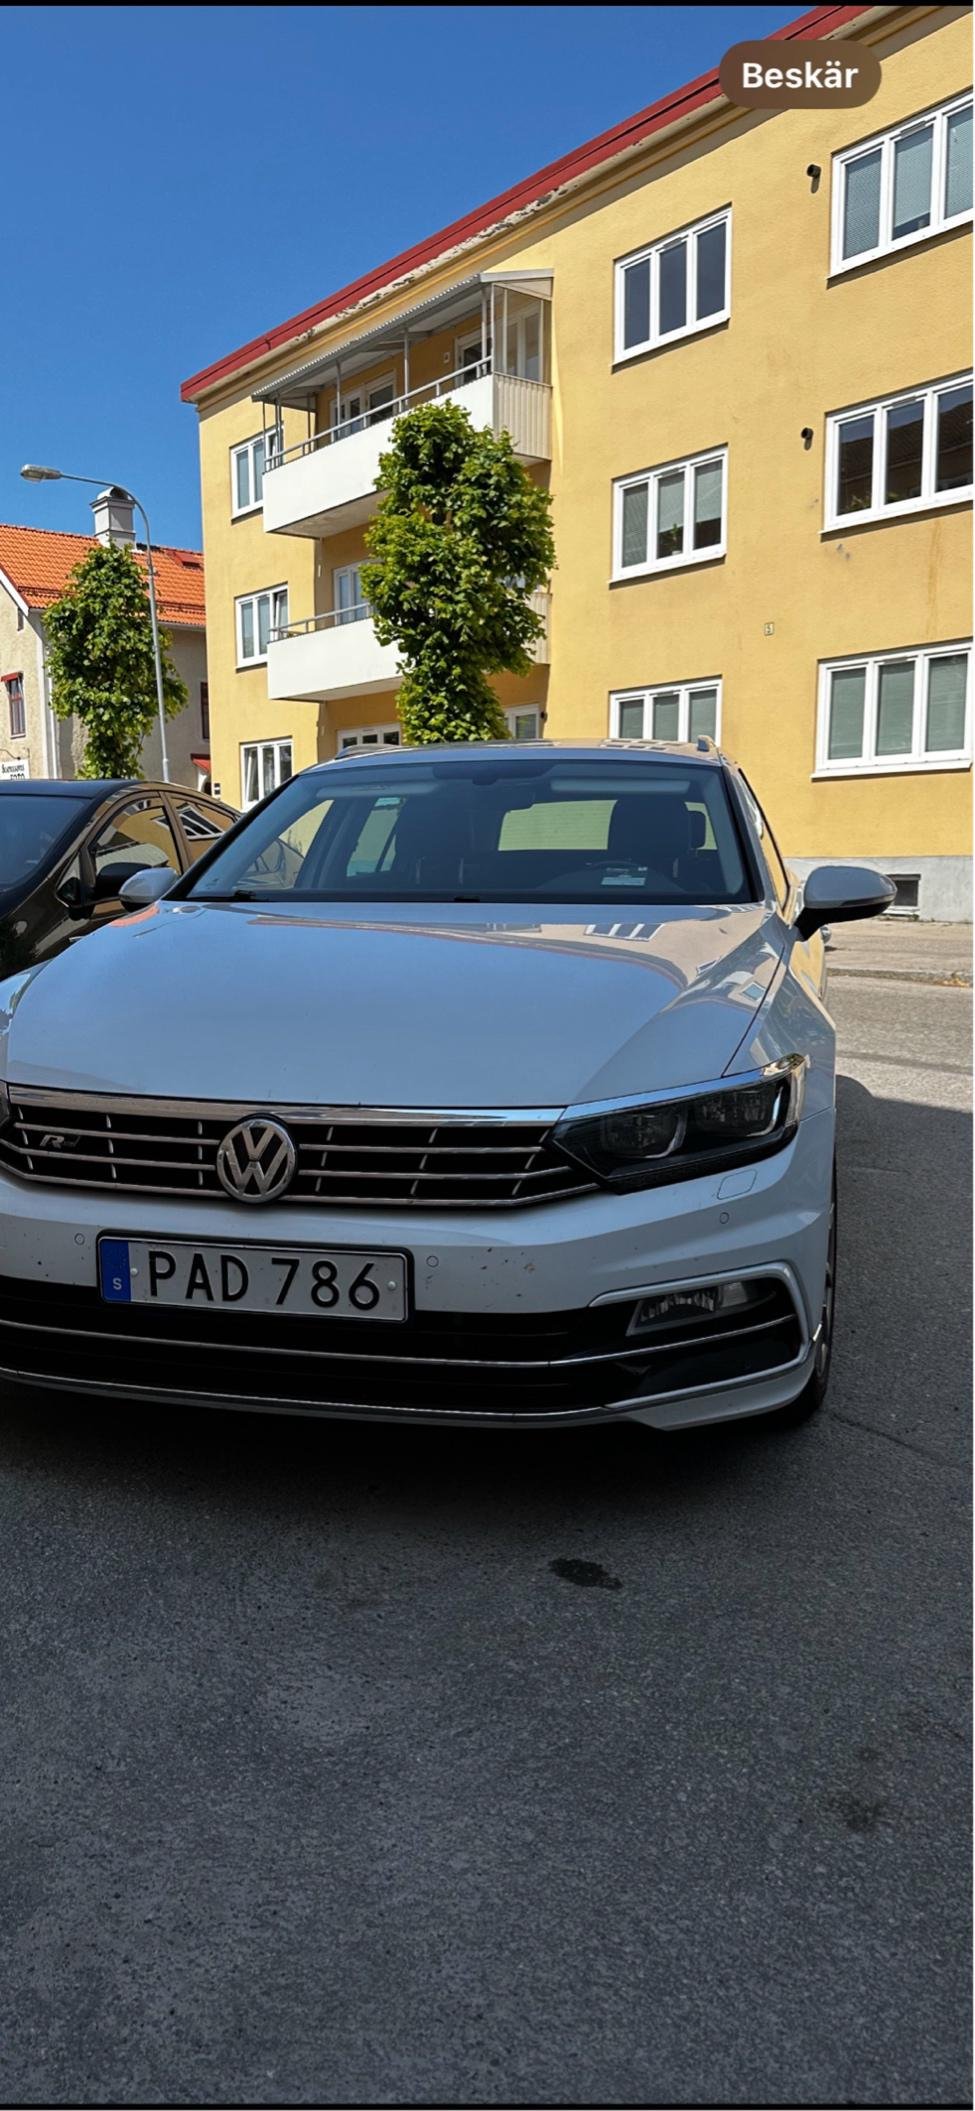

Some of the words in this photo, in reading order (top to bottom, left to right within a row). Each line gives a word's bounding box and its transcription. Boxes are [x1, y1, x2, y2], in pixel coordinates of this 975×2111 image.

[220, 1119, 296, 1201] VW
[112, 1278, 123, 1290] S
[148, 1250, 250, 1302] PAD
[271, 1257, 380, 1311] 786
